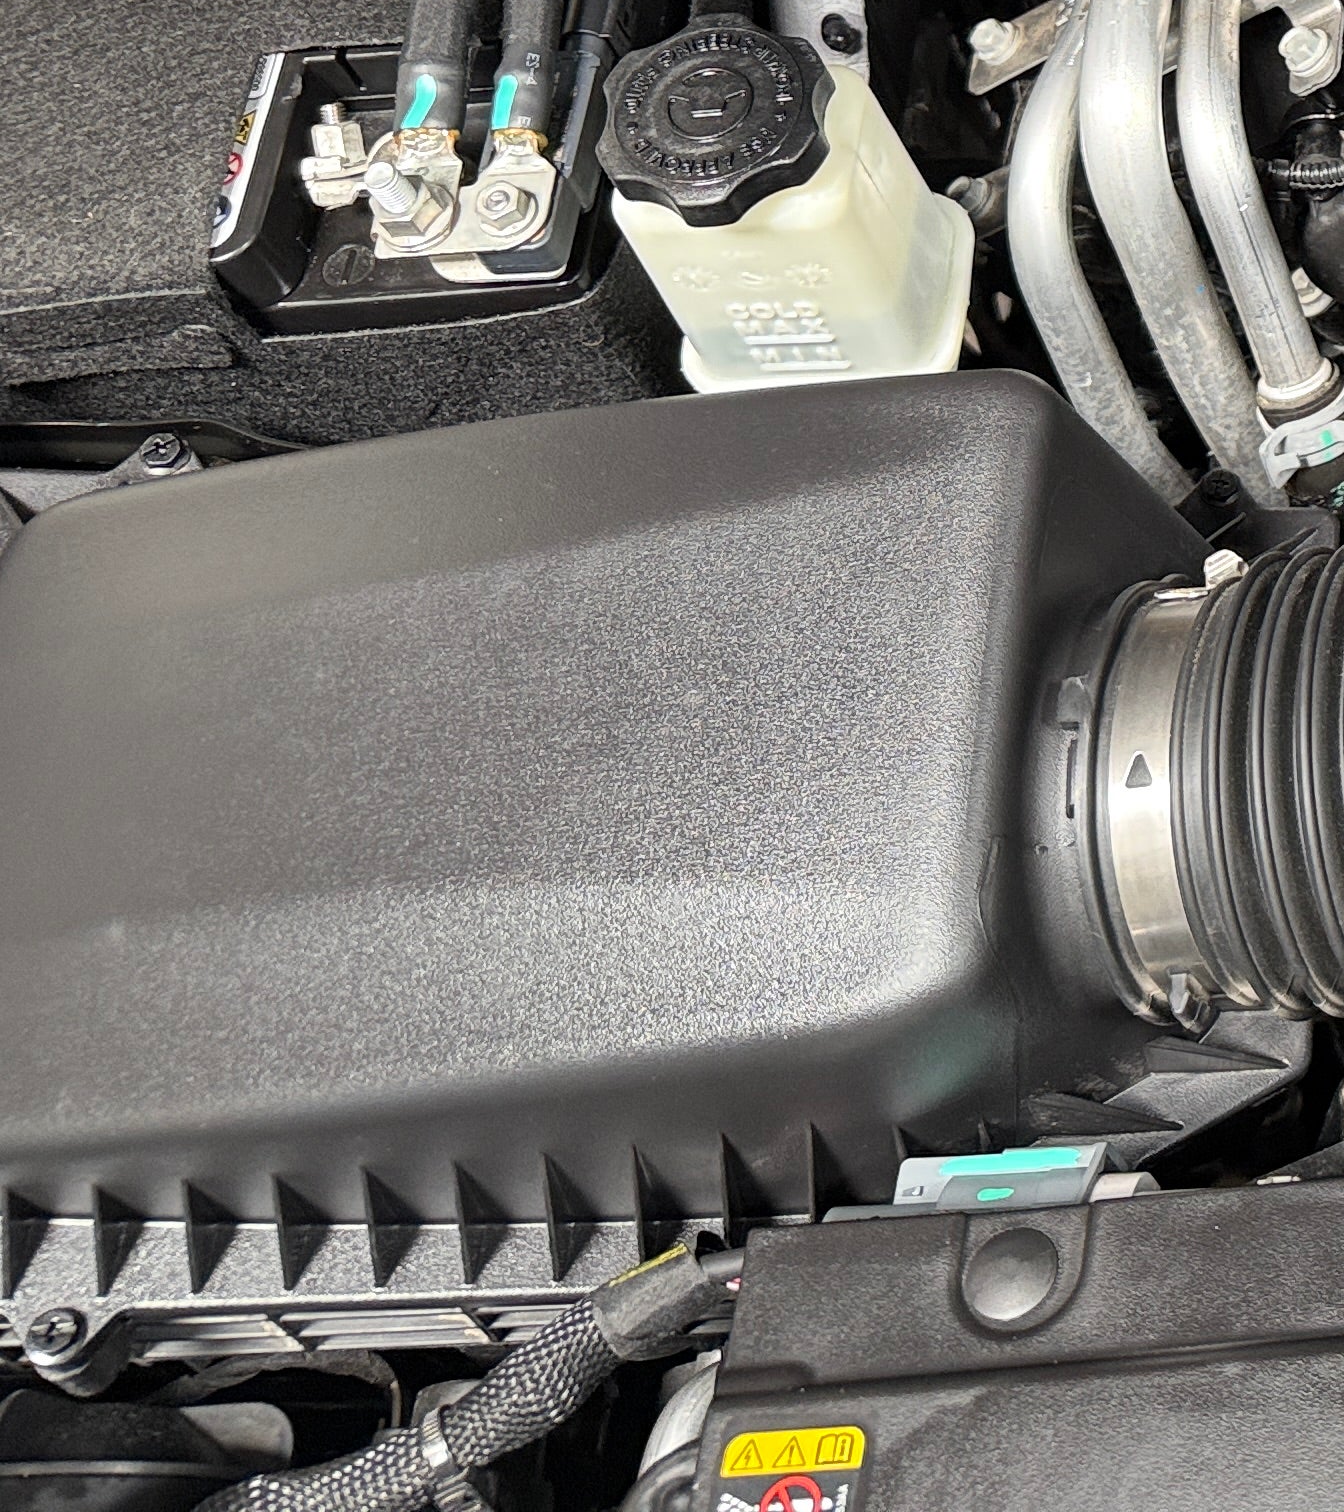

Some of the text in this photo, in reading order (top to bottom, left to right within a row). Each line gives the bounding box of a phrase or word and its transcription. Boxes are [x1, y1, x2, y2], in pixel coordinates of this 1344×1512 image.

[725, 301, 823, 320] COLD
[734, 319, 833, 336] MAX
[748, 346, 841, 363] MIN
